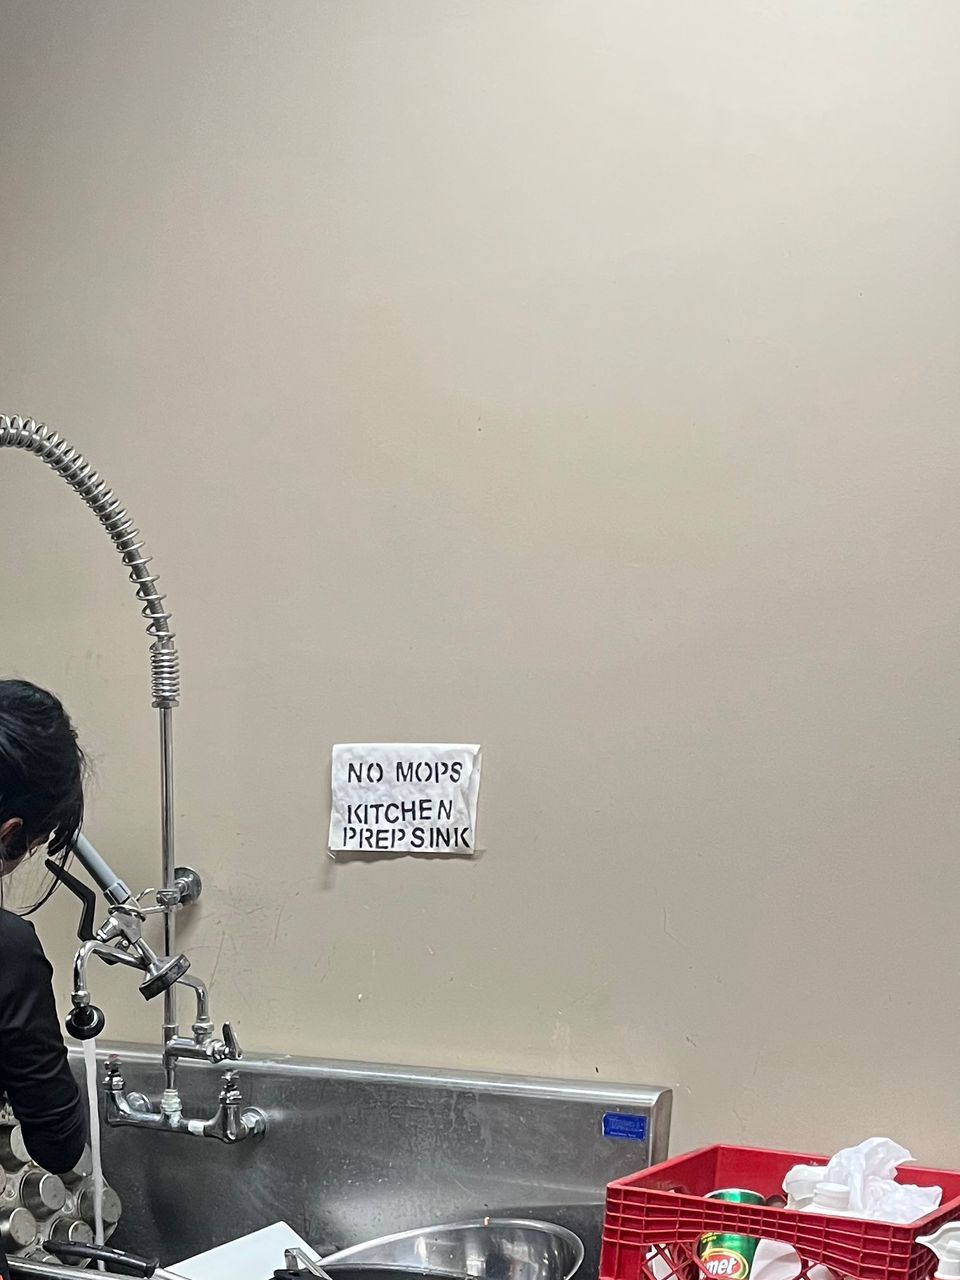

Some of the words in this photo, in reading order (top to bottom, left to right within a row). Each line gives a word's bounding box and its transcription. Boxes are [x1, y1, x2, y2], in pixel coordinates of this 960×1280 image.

[347, 762, 384, 783] NO
[396, 761, 463, 783] MOPS
[347, 799, 453, 824] KITCHEN
[343, 827, 406, 849] PREP
[410, 827, 471, 848] SINK
